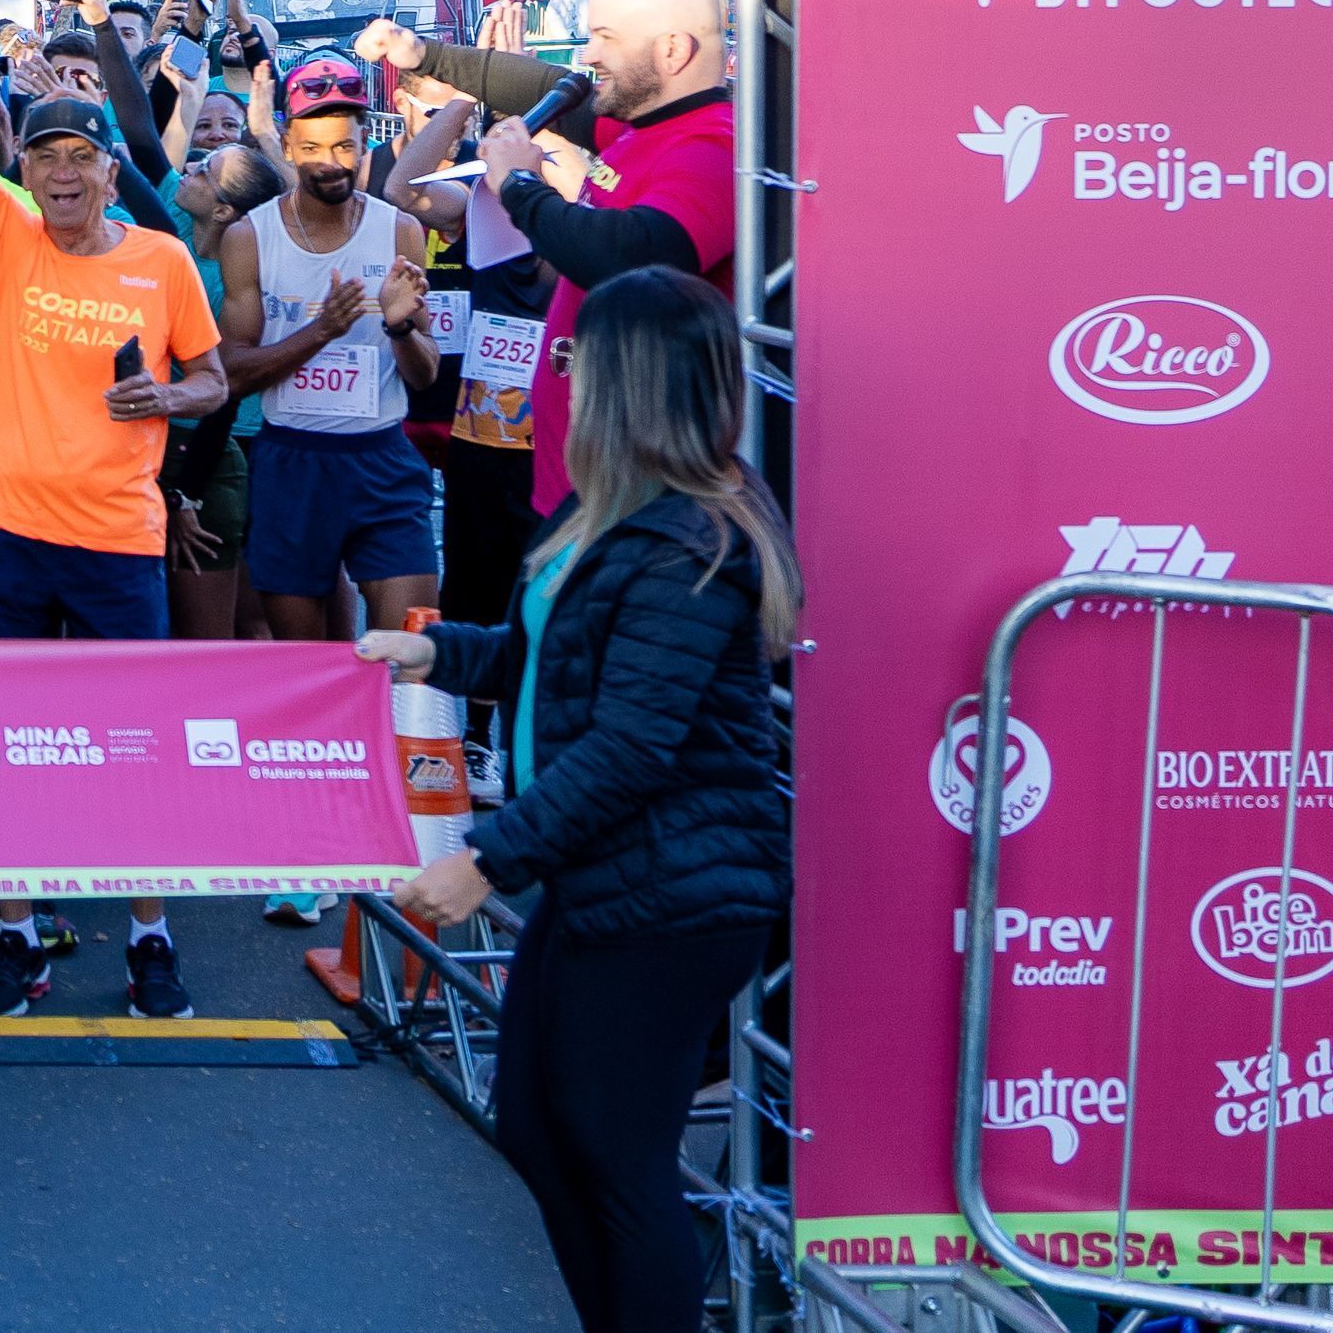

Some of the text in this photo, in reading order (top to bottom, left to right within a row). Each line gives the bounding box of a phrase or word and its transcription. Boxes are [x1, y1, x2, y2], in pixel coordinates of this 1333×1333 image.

[1074, 122, 1171, 143] POSTO
[23, 286, 146, 327] CORRIDA
[479, 334, 536, 365] 5252
[294, 367, 360, 392] 5507
[3, 725, 91, 747] MINAS
[5, 745, 107, 766] GERAIS
[244, 739, 368, 763] GERDAU
[1156, 750, 1214, 789] BIO
[1155, 792, 1280, 810] COSMÉTICOS
[40, 879, 81, 894] NA
[91, 877, 196, 893] NOSSA
[983, 1067, 1127, 1125] uatree
